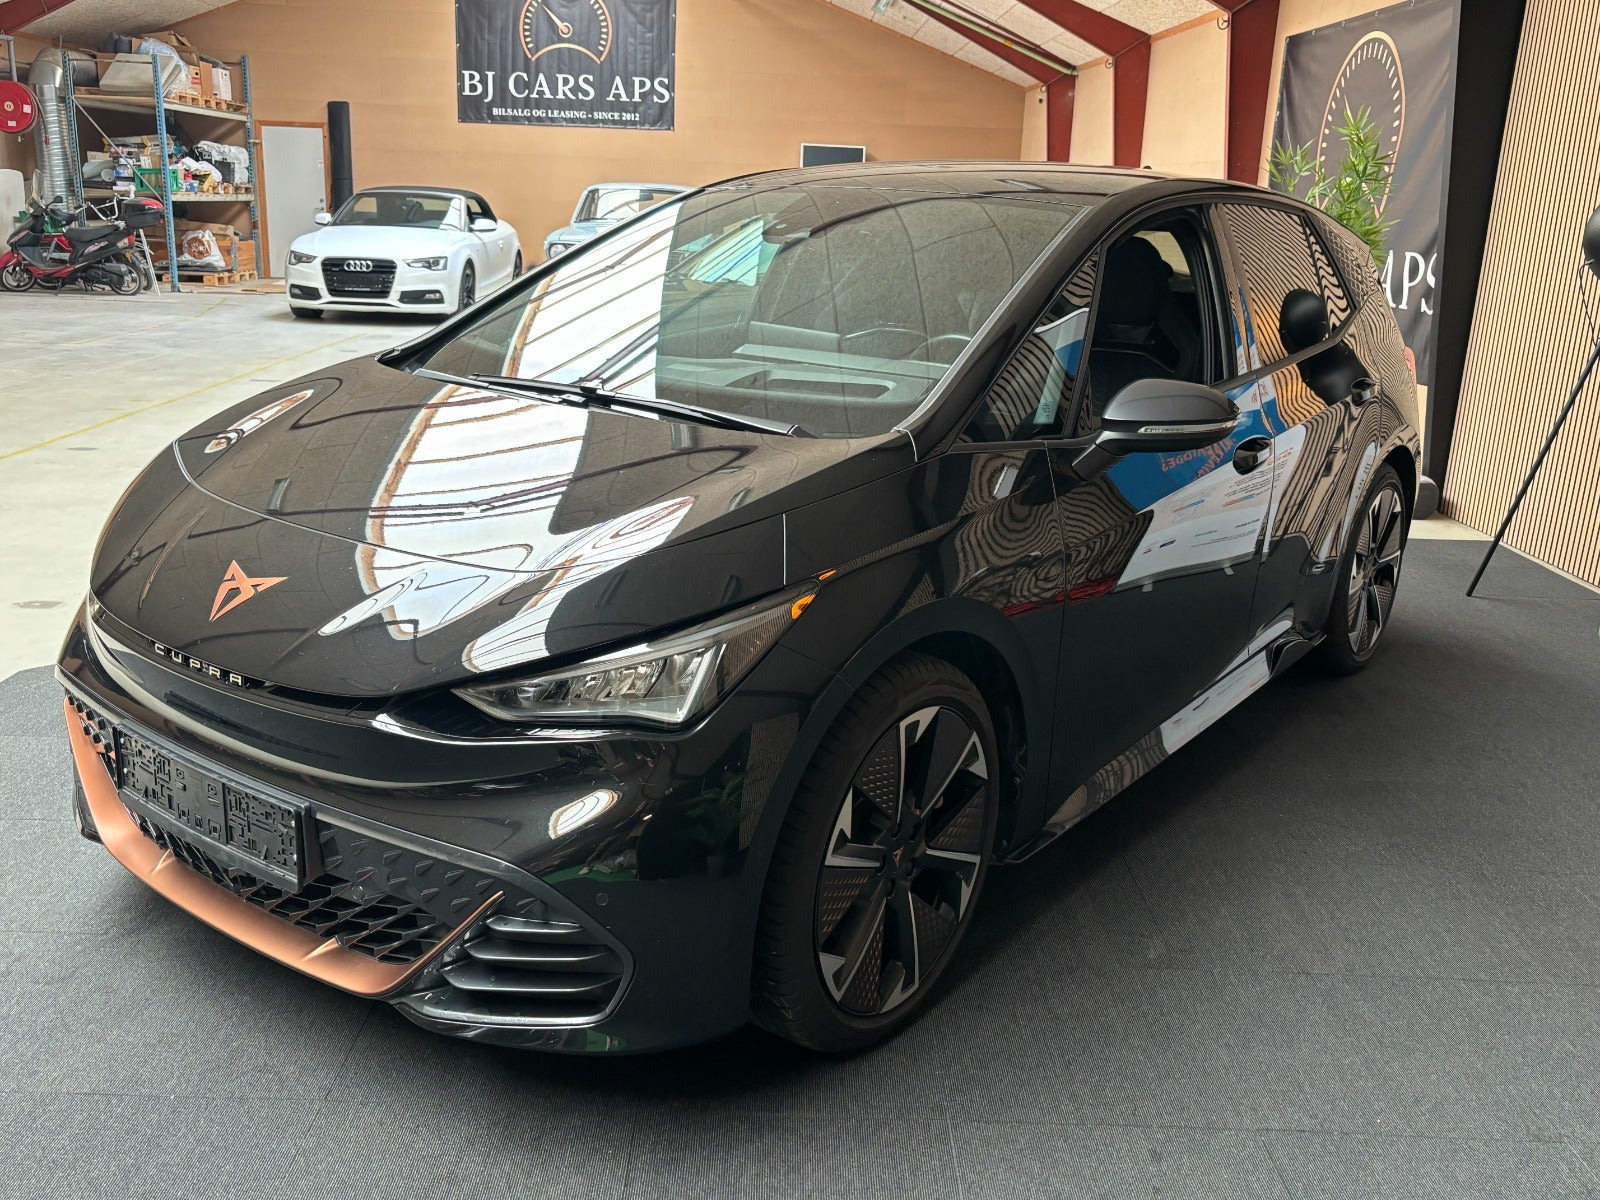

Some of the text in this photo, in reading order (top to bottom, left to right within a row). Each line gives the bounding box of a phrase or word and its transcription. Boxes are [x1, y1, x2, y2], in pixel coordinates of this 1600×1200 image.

[461, 70, 671, 104] BJ CARS APS
[492, 107, 531, 117] BILSALG
[532, 109, 546, 118] OG
[548, 109, 587, 120] LEASING
[593, 111, 620, 120] SINCE
[621, 112, 640, 121] 2012
[154, 642, 242, 686] CUPRA
